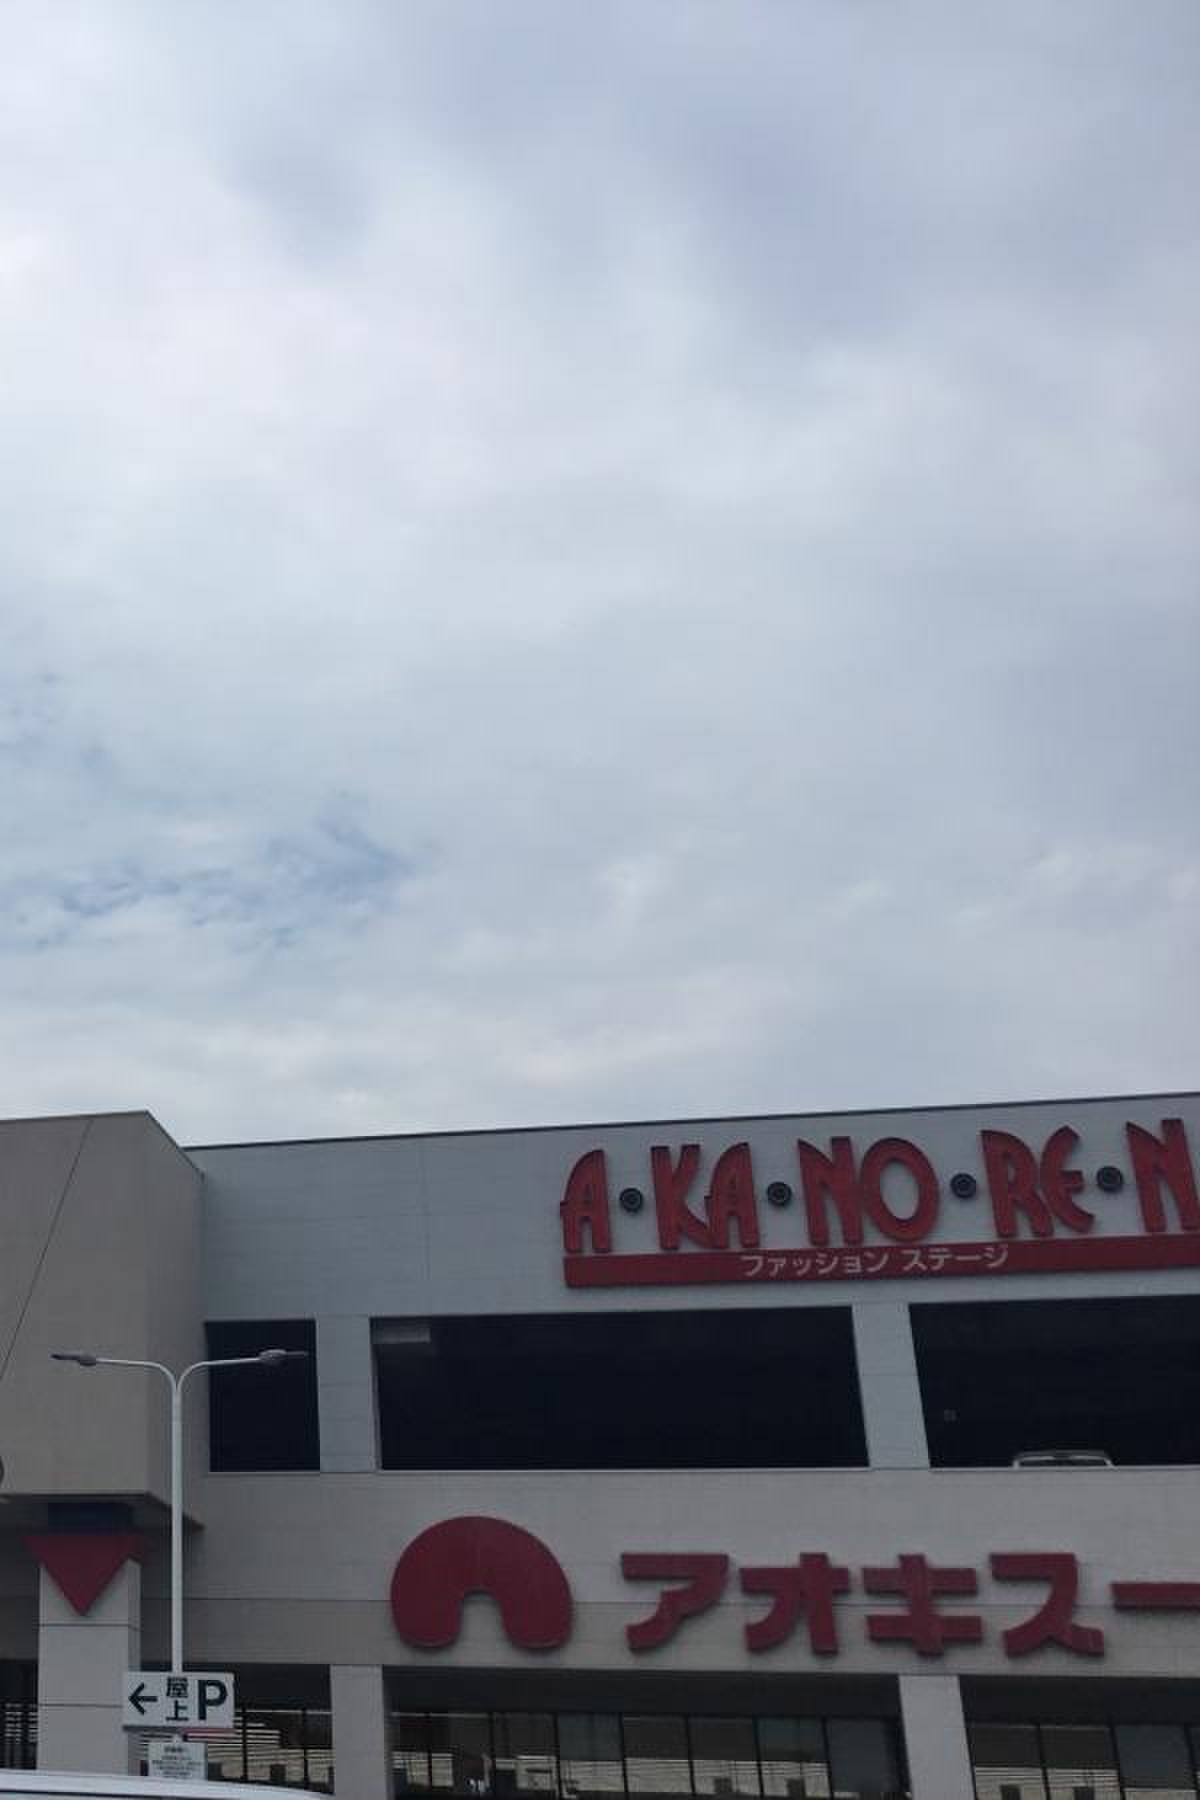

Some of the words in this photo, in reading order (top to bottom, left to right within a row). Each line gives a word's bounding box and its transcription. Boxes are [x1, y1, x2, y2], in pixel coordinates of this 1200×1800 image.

[739, 1252, 888, 1276] ファッション
[903, 1243, 1008, 1271] ステージ
[197, 1679, 228, 1721] P
